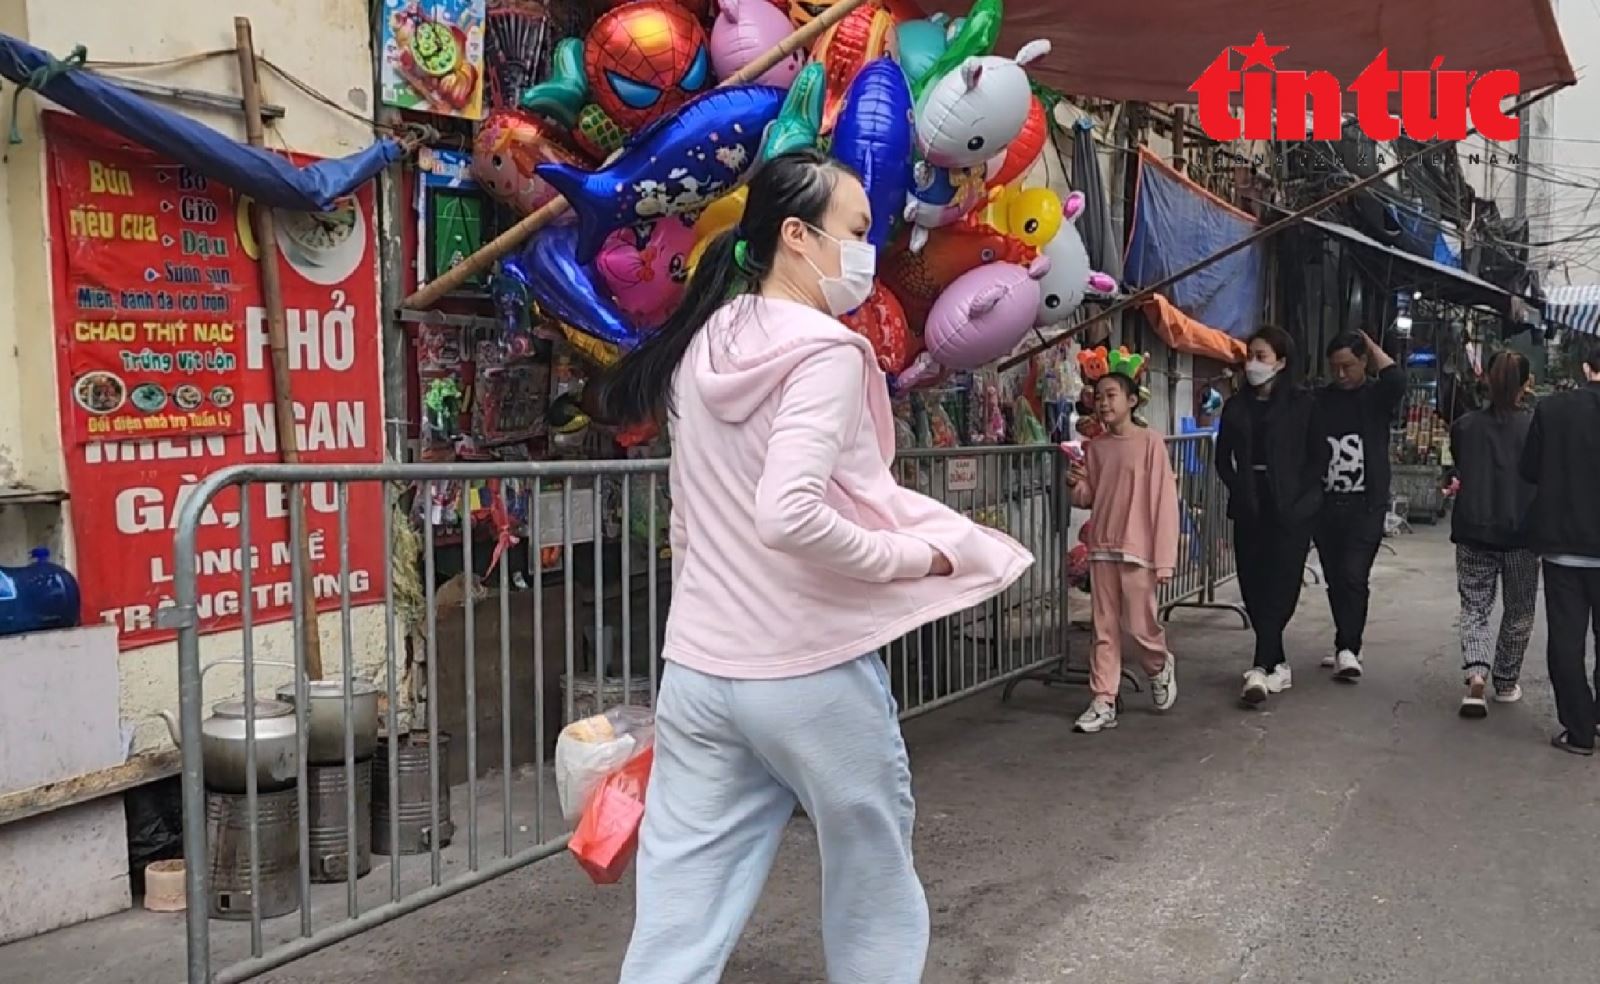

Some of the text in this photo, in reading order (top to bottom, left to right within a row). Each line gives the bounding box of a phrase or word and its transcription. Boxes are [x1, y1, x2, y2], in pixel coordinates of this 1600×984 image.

[120, 212, 159, 241] cua
[193, 322, 235, 347] NẠC
[246, 290, 355, 371] PHỞ
